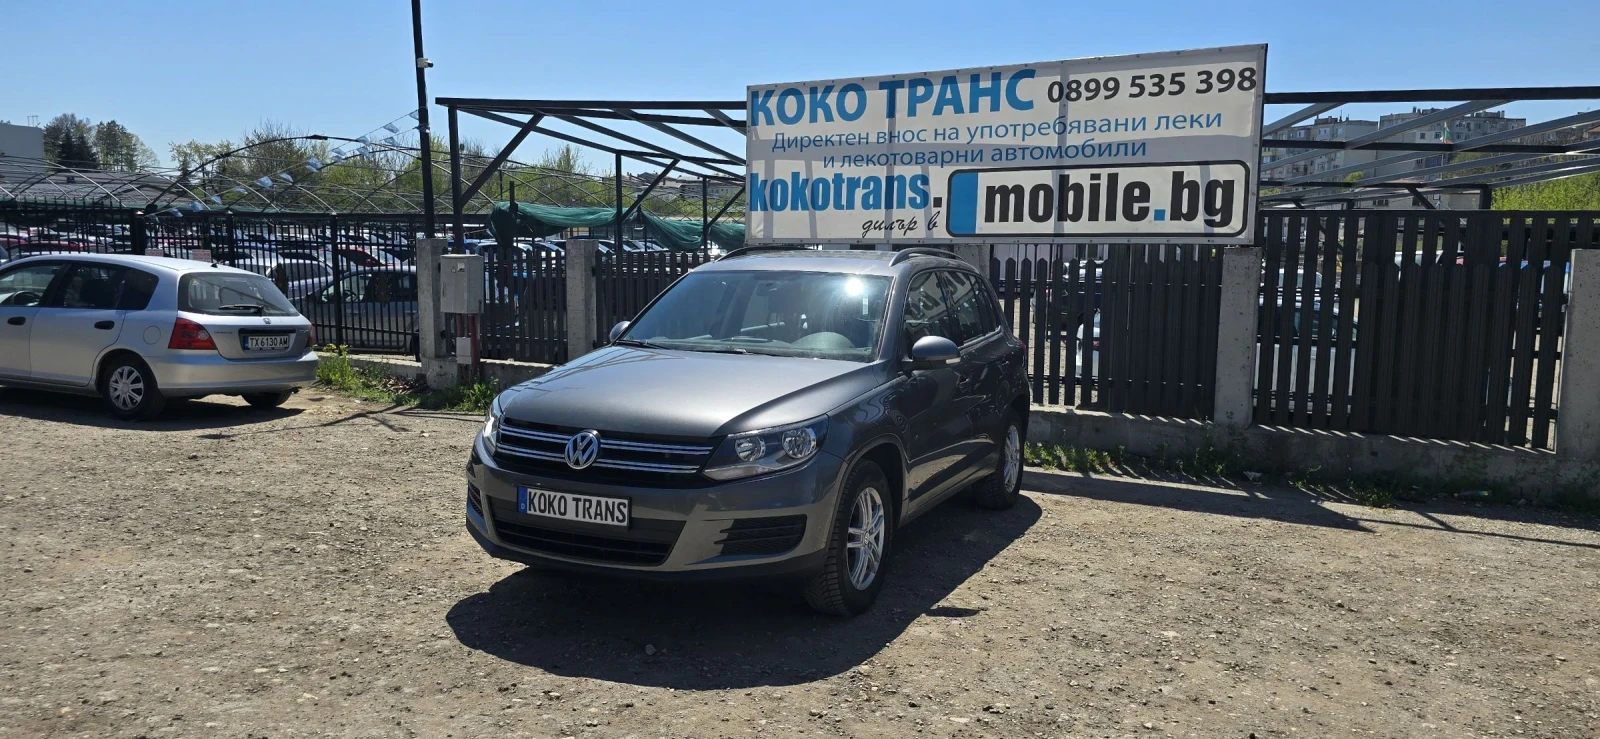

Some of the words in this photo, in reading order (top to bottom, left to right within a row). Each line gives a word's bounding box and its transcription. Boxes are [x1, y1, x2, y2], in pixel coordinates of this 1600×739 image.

[751, 83, 867, 126] КОКО
[879, 68, 1036, 118] ТРАНС
[1047, 77, 1120, 103] 0899
[1128, 72, 1186, 98] 535
[1196, 67, 1257, 94] 398
[772, 131, 869, 152] Директен
[876, 129, 927, 144] внос
[934, 127, 959, 141] на
[967, 115, 1147, 145] употребявани
[1154, 112, 1222, 131] леки
[823, 156, 835, 168] и
[840, 148, 983, 168] лекотоварни
[990, 138, 1147, 162] автомобили
[984, 171, 1235, 228] mobile.bg
[861, 216, 918, 238] дилър
[927, 210, 941, 231] в
[249, 338, 260, 347] TX
[261, 337, 277, 347] 6130
[528, 491, 568, 517] KOKO
[572, 496, 627, 523] TRANS
